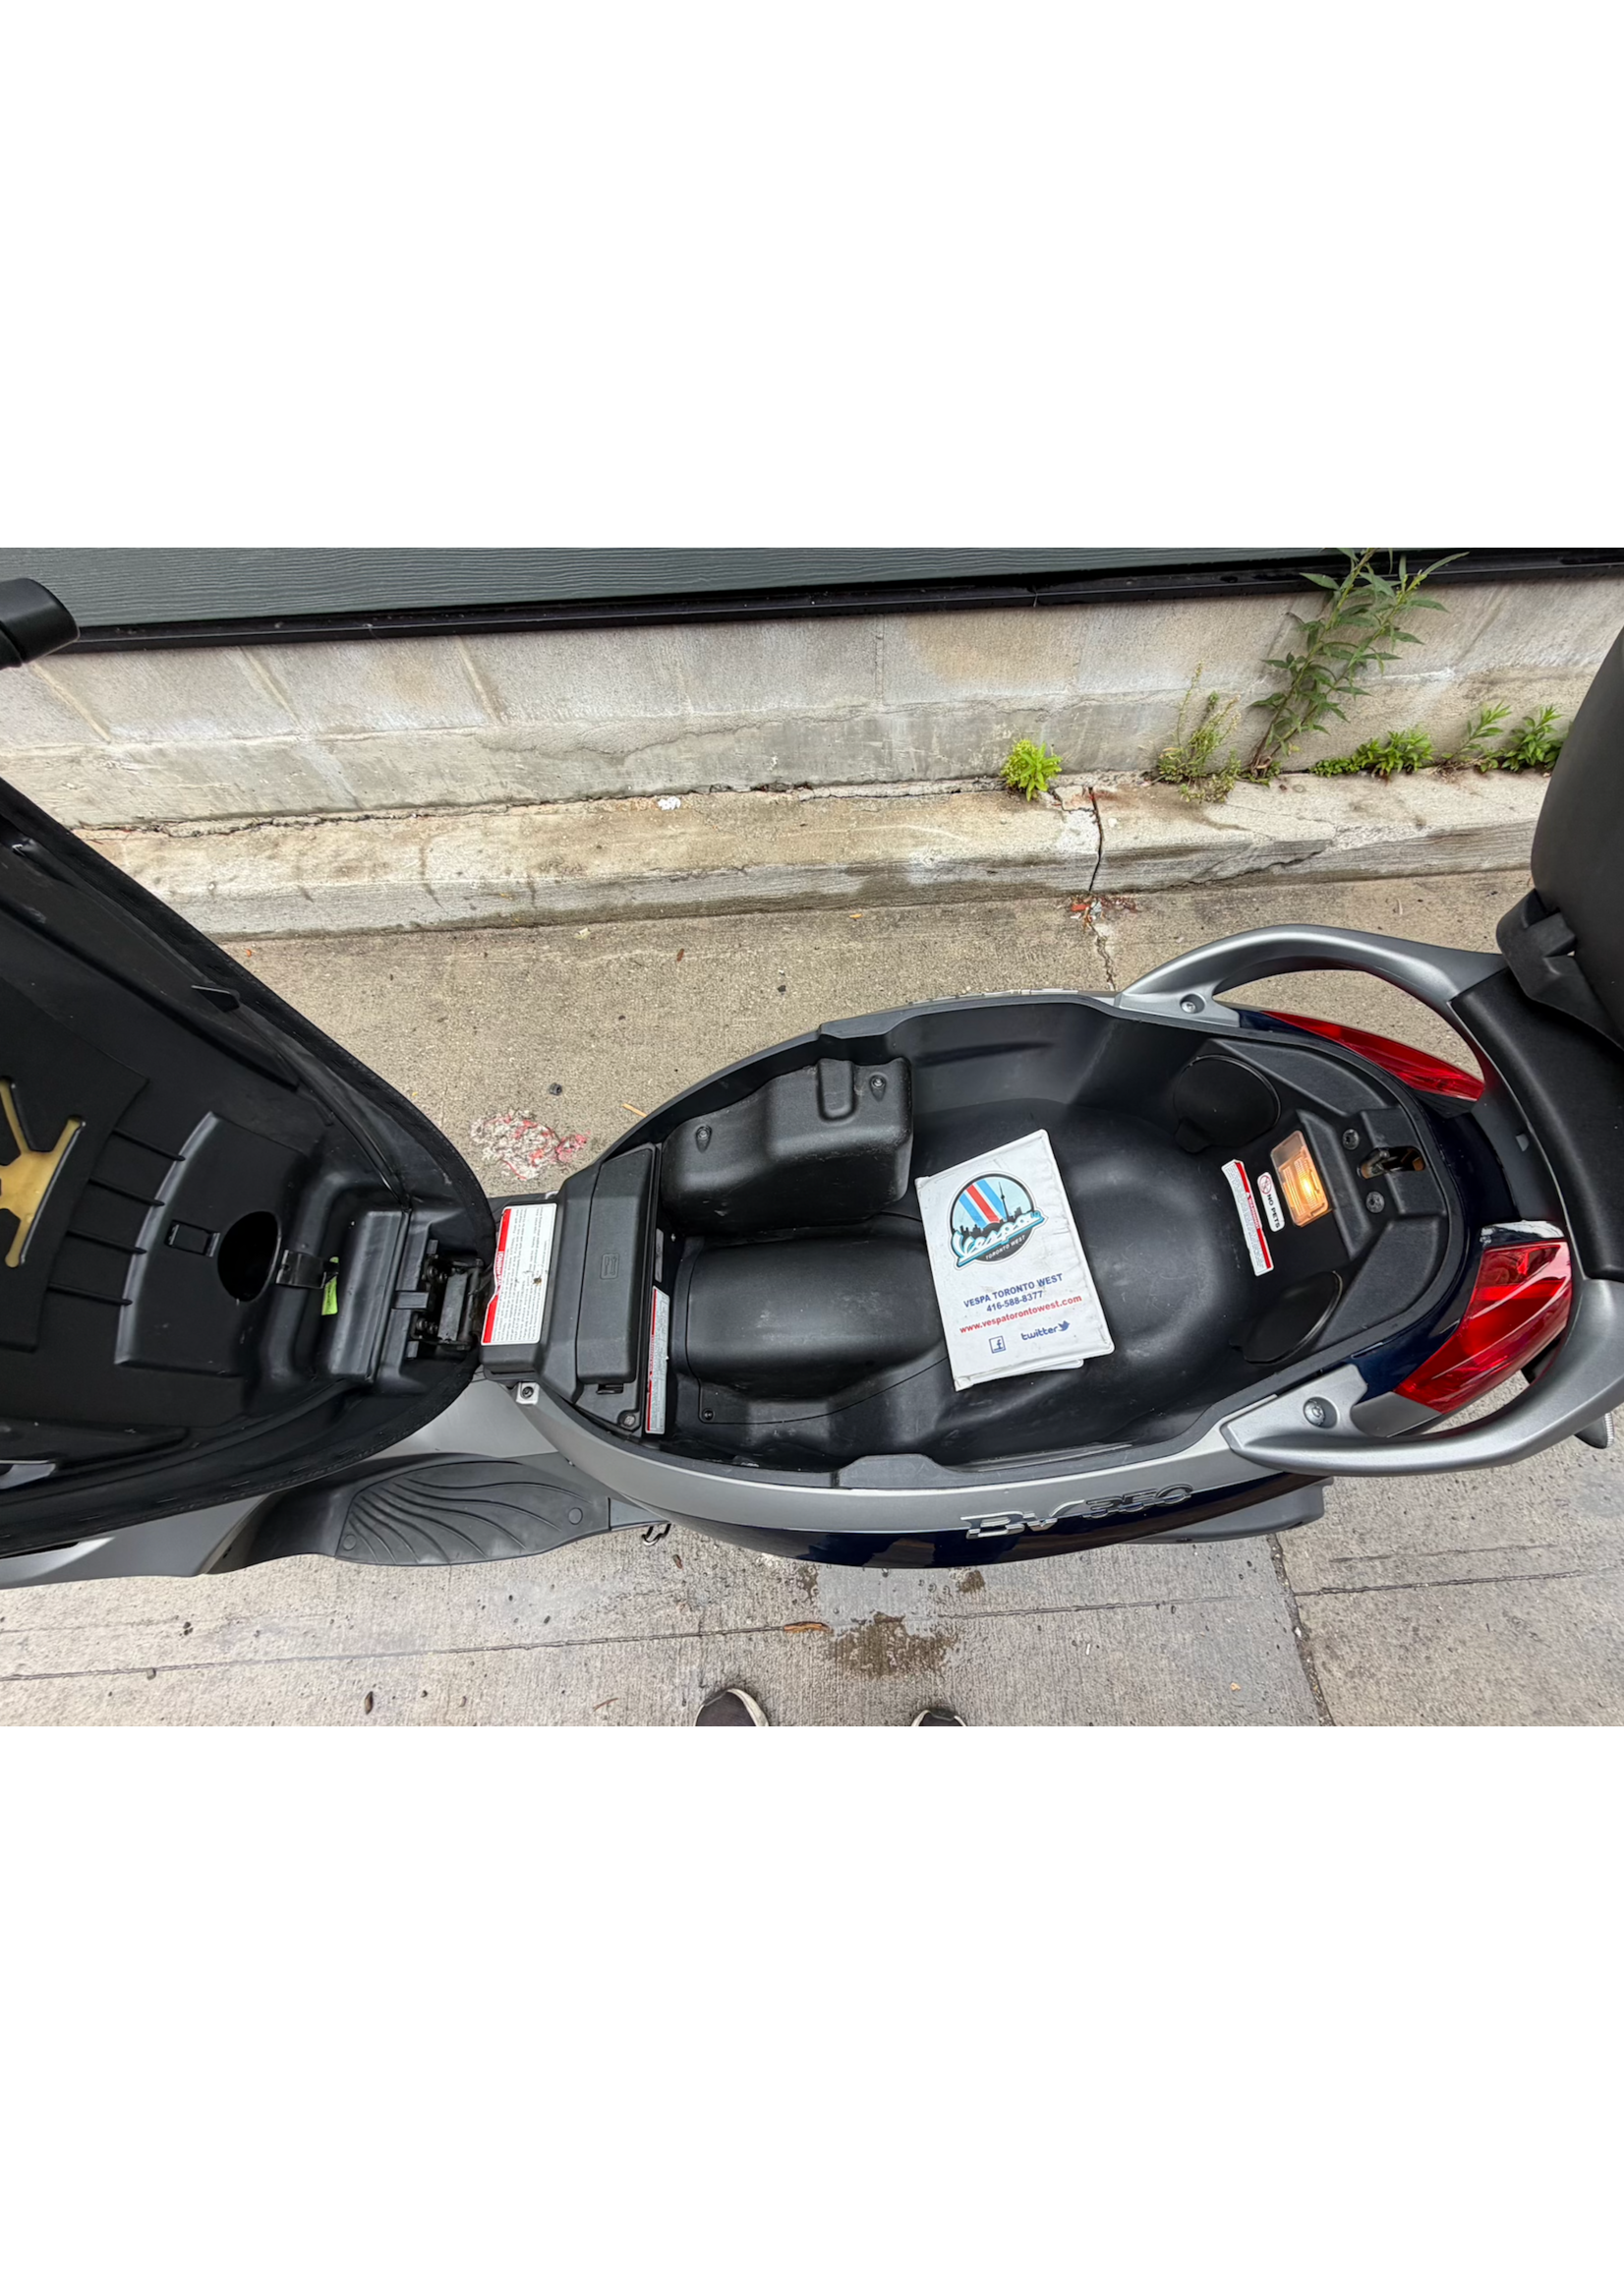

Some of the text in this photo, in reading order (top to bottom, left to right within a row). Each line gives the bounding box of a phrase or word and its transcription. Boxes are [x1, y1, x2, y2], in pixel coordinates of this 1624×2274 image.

[1267, 1194, 1280, 1228] NO PETS
[985, 1235, 1026, 1259] TORONTO WEST
[963, 1273, 1063, 1308] VESPA TORONTO WEST
[986, 1290, 1043, 1312] 416-588-8377
[959, 1295, 1082, 1333] www.vespatorontowest.com
[1020, 1325, 1059, 1341] twitter
